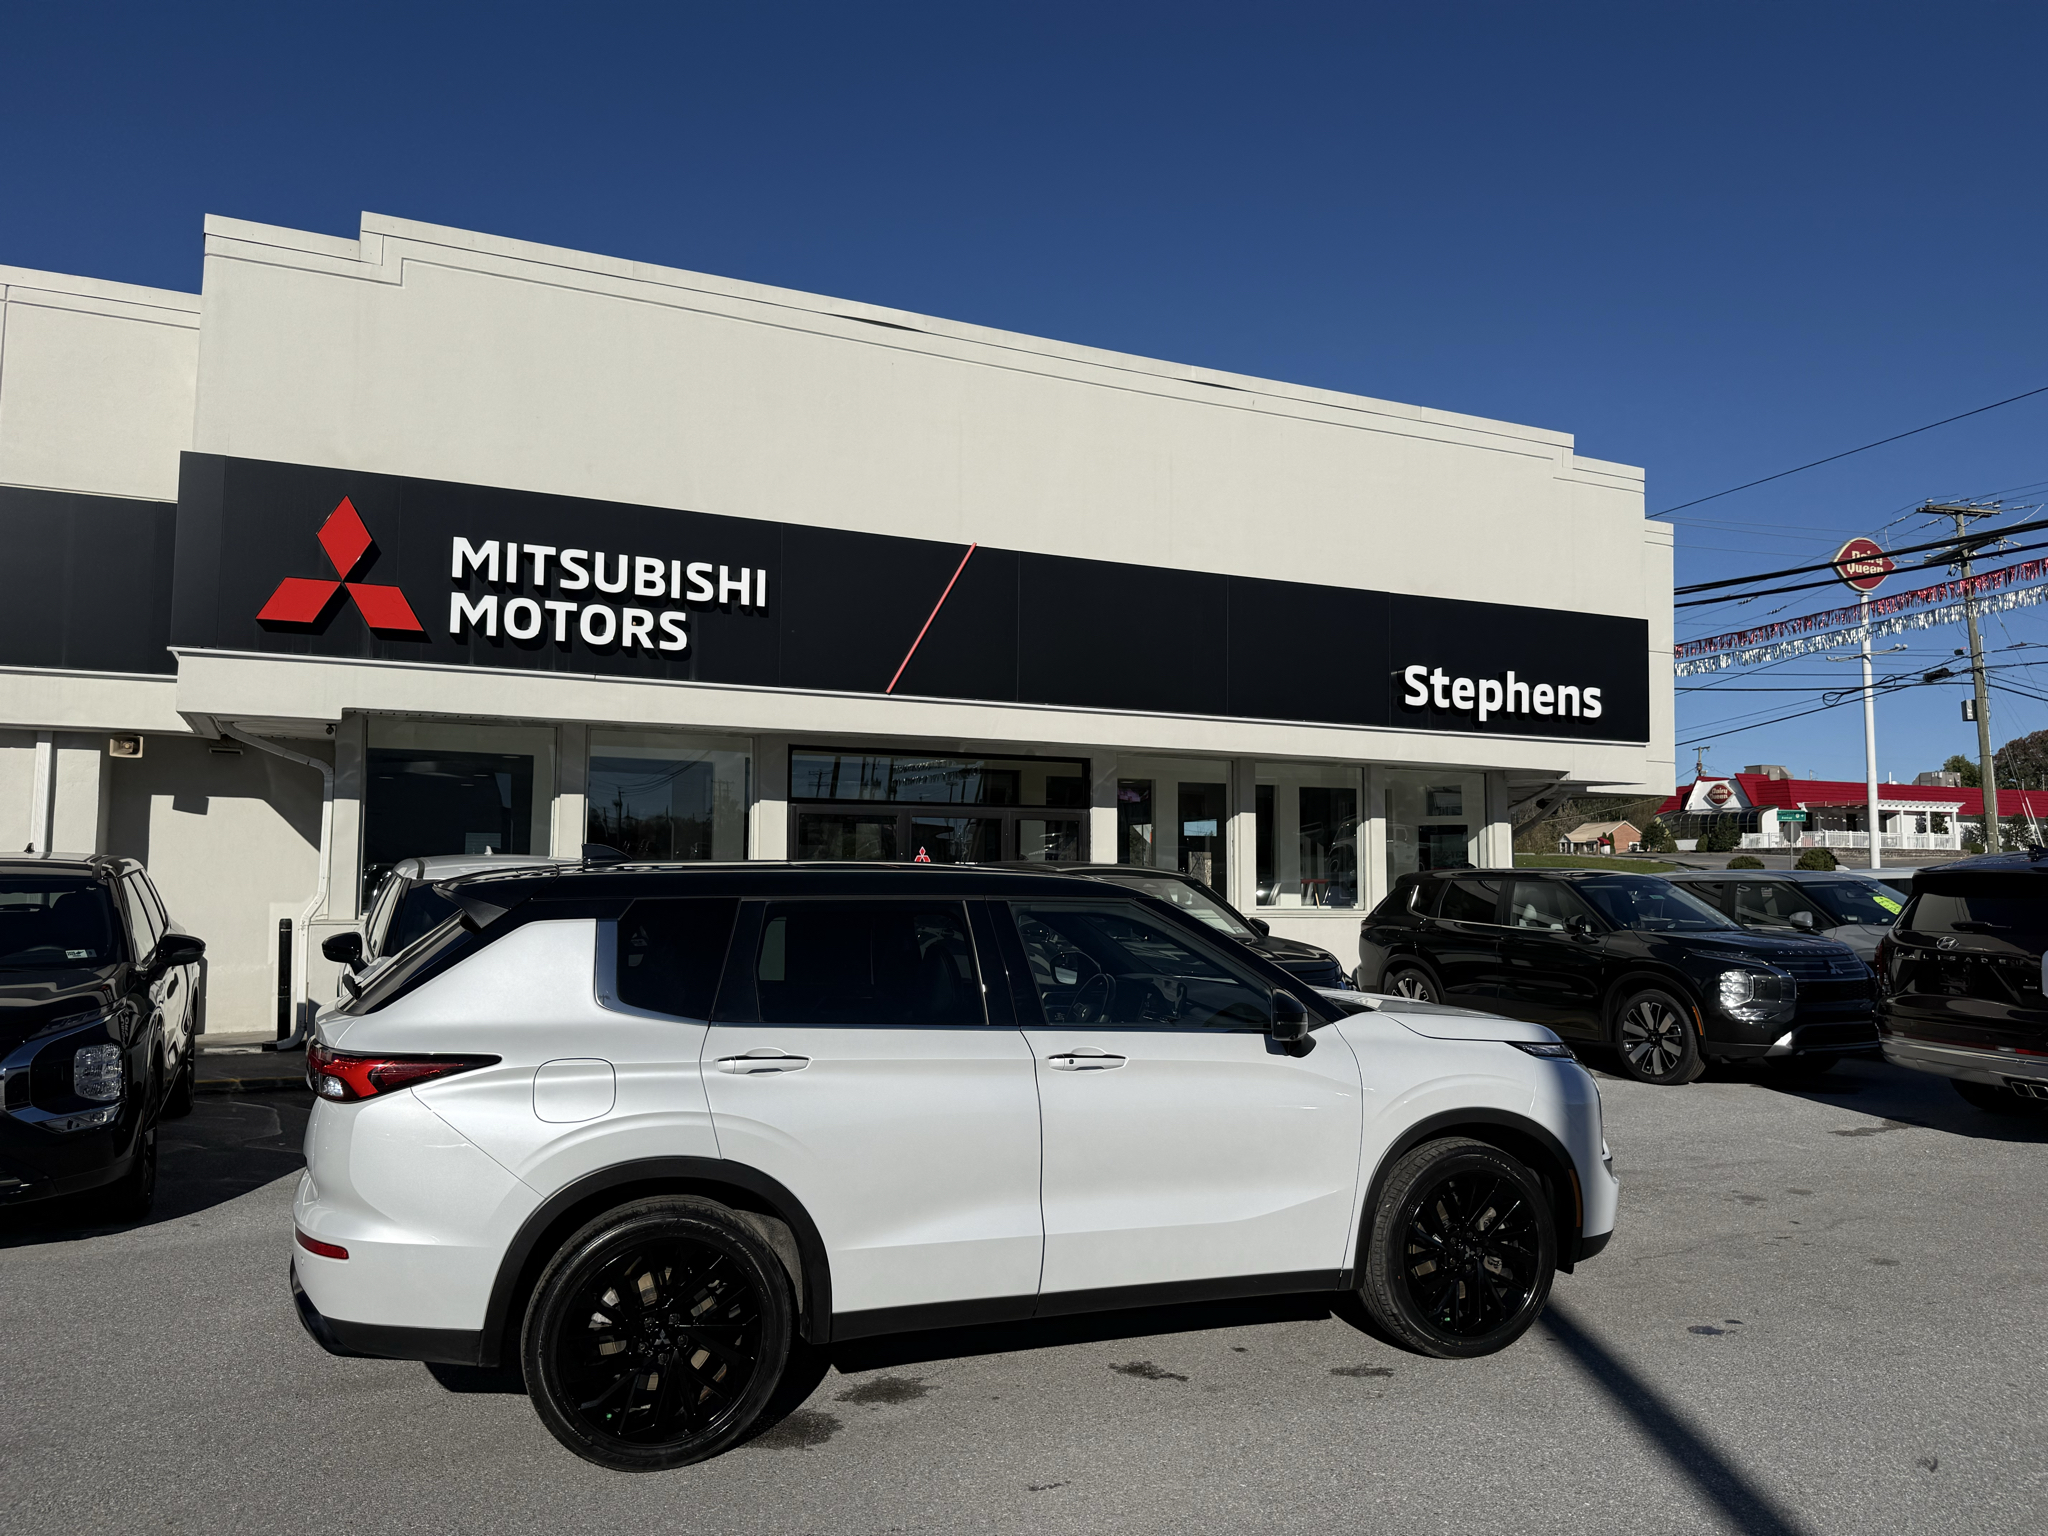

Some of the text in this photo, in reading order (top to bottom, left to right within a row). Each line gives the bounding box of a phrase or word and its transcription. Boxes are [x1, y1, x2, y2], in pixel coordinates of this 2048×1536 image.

[452, 537, 766, 607] MITSUBISHI
[1846, 562, 1884, 575] Queen
[450, 592, 688, 651] MOTORS
[1404, 665, 1602, 722] Stephens
